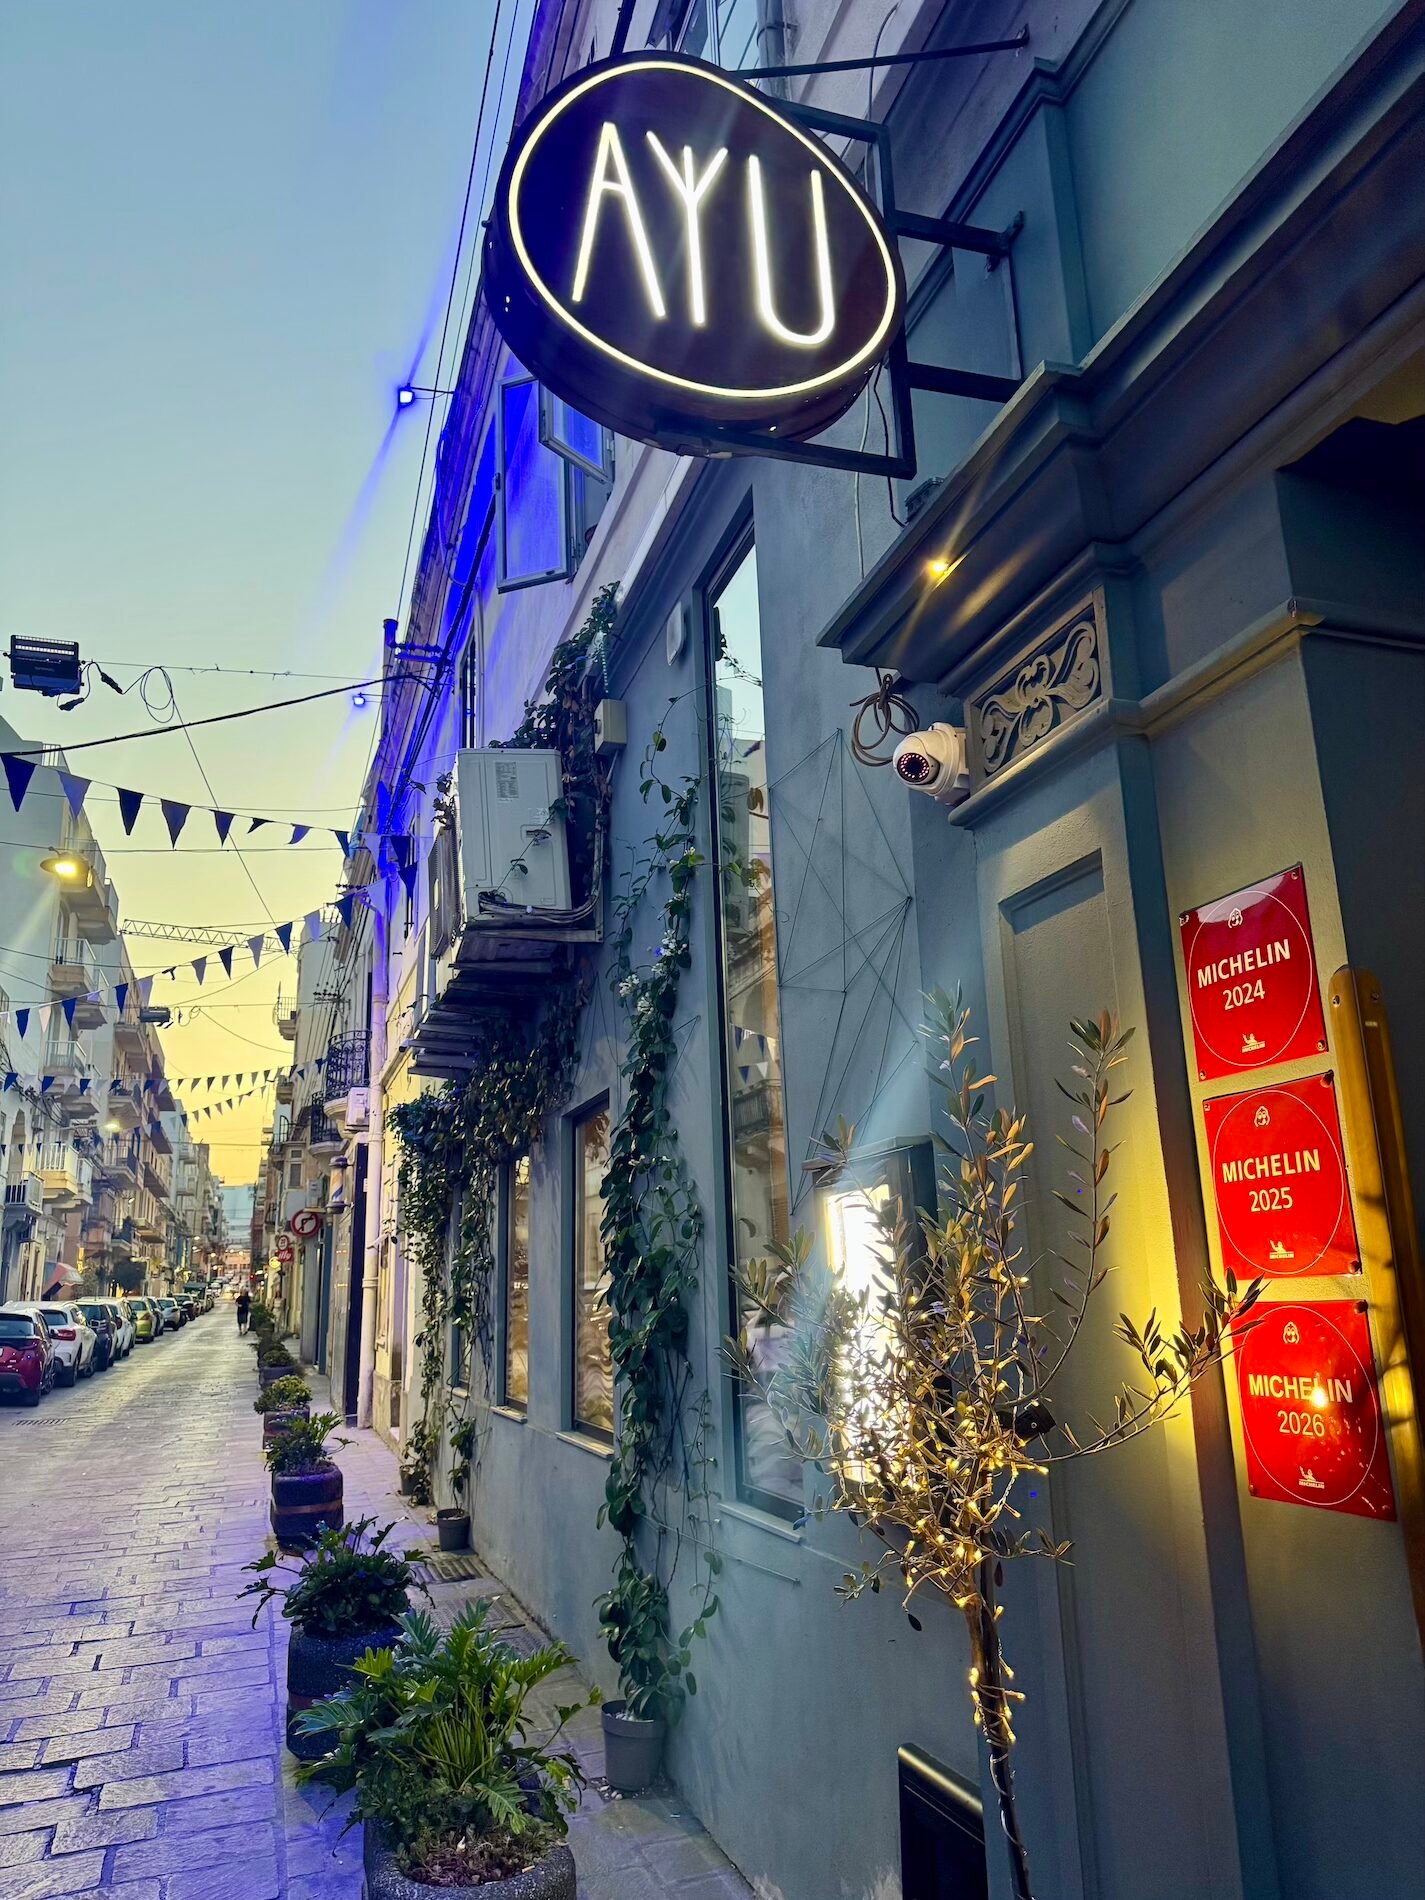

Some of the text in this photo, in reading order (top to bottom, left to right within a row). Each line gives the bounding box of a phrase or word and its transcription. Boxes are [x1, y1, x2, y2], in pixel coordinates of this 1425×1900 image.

[572, 121, 836, 347] AYU
[1197, 938, 1291, 988] MICHELIN
[1222, 978, 1266, 1011] 2024
[1222, 1148, 1321, 1184] MICHELIN
[1249, 1186, 1294, 1213] 2025
[1277, 1409, 1326, 1438] 2026
